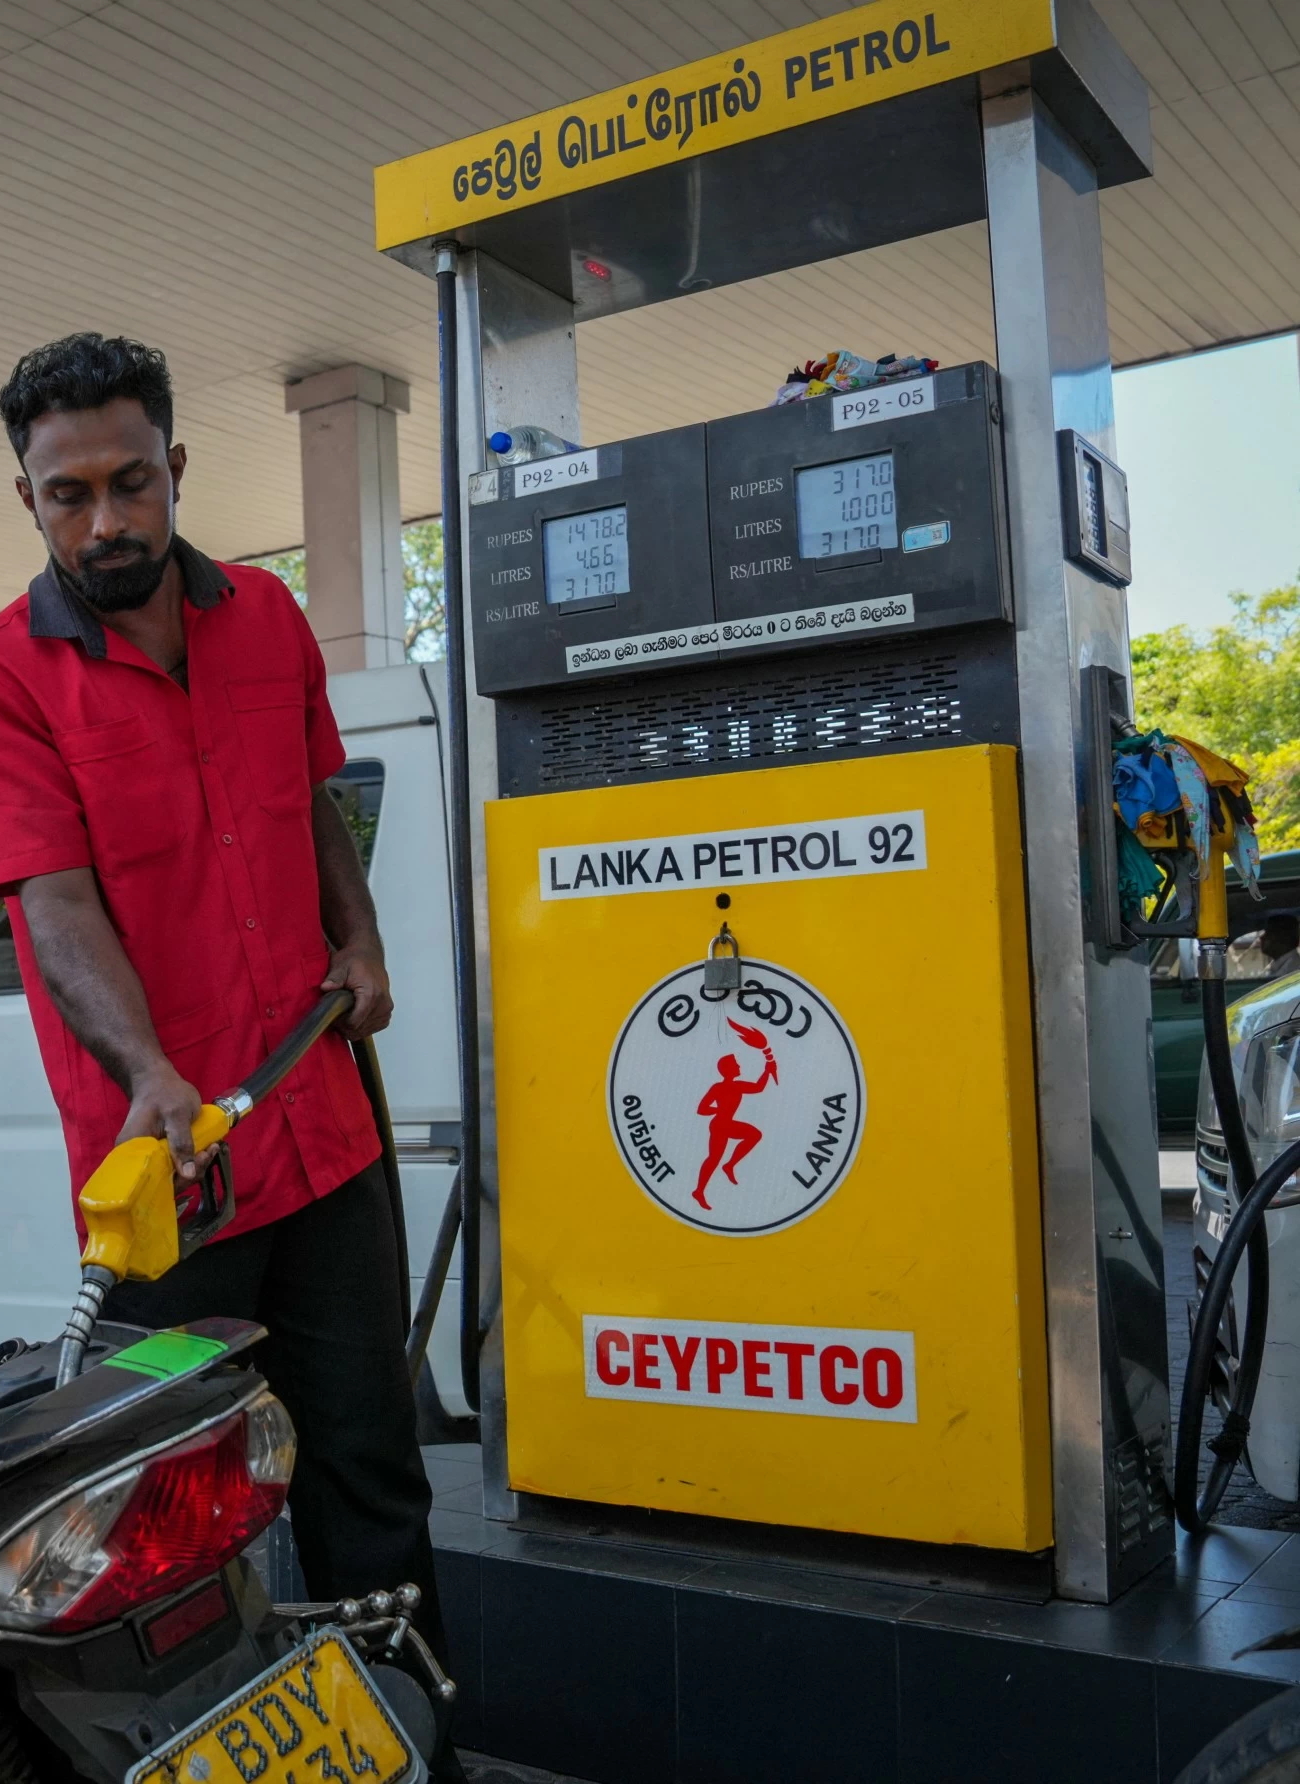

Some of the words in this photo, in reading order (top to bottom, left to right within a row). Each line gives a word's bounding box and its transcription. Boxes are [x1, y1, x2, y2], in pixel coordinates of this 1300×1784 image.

[785, 13, 951, 100] PETROL
[557, 57, 762, 169] பெட்ரோல்
[843, 398, 880, 420] P92
[898, 388, 924, 408] 05
[523, 469, 553, 489] P92
[568, 461, 590, 478] 04
[730, 477, 784, 500] RUPEES
[833, 461, 892, 494] 317.0
[842, 491, 894, 522] 1.000
[487, 528, 533, 549] RUPEES
[568, 514, 626, 544] 1478.2
[735, 518, 782, 539] LITRES
[822, 524, 880, 556] 317.0
[577, 544, 614, 569] 4.66
[729, 556, 793, 580] RS/LITRE
[491, 566, 531, 585] LITRES
[565, 571, 616, 600] 317.0
[486, 601, 540, 622] RS/LITRE
[572, 648, 611, 668] ඉන්ධන
[614, 643, 638, 661] ලබා
[642, 635, 688, 653] ගැනීමට
[691, 629, 719, 646] පෙර
[722, 624, 763, 641] මීටරය
[767, 621, 776, 635] 0
[780, 618, 791, 632] ට
[860, 601, 907, 622] බලන්න
[550, 845, 684, 891] LANKA
[693, 829, 857, 880] PETROL
[868, 822, 915, 865] 92
[623, 1094, 675, 1183] லங்கா
[792, 1093, 847, 1189] LANKA
[595, 1328, 904, 1410] CEYPETCO
[215, 1666, 330, 1783] BDY
[284, 1728, 380, 1784] 34
